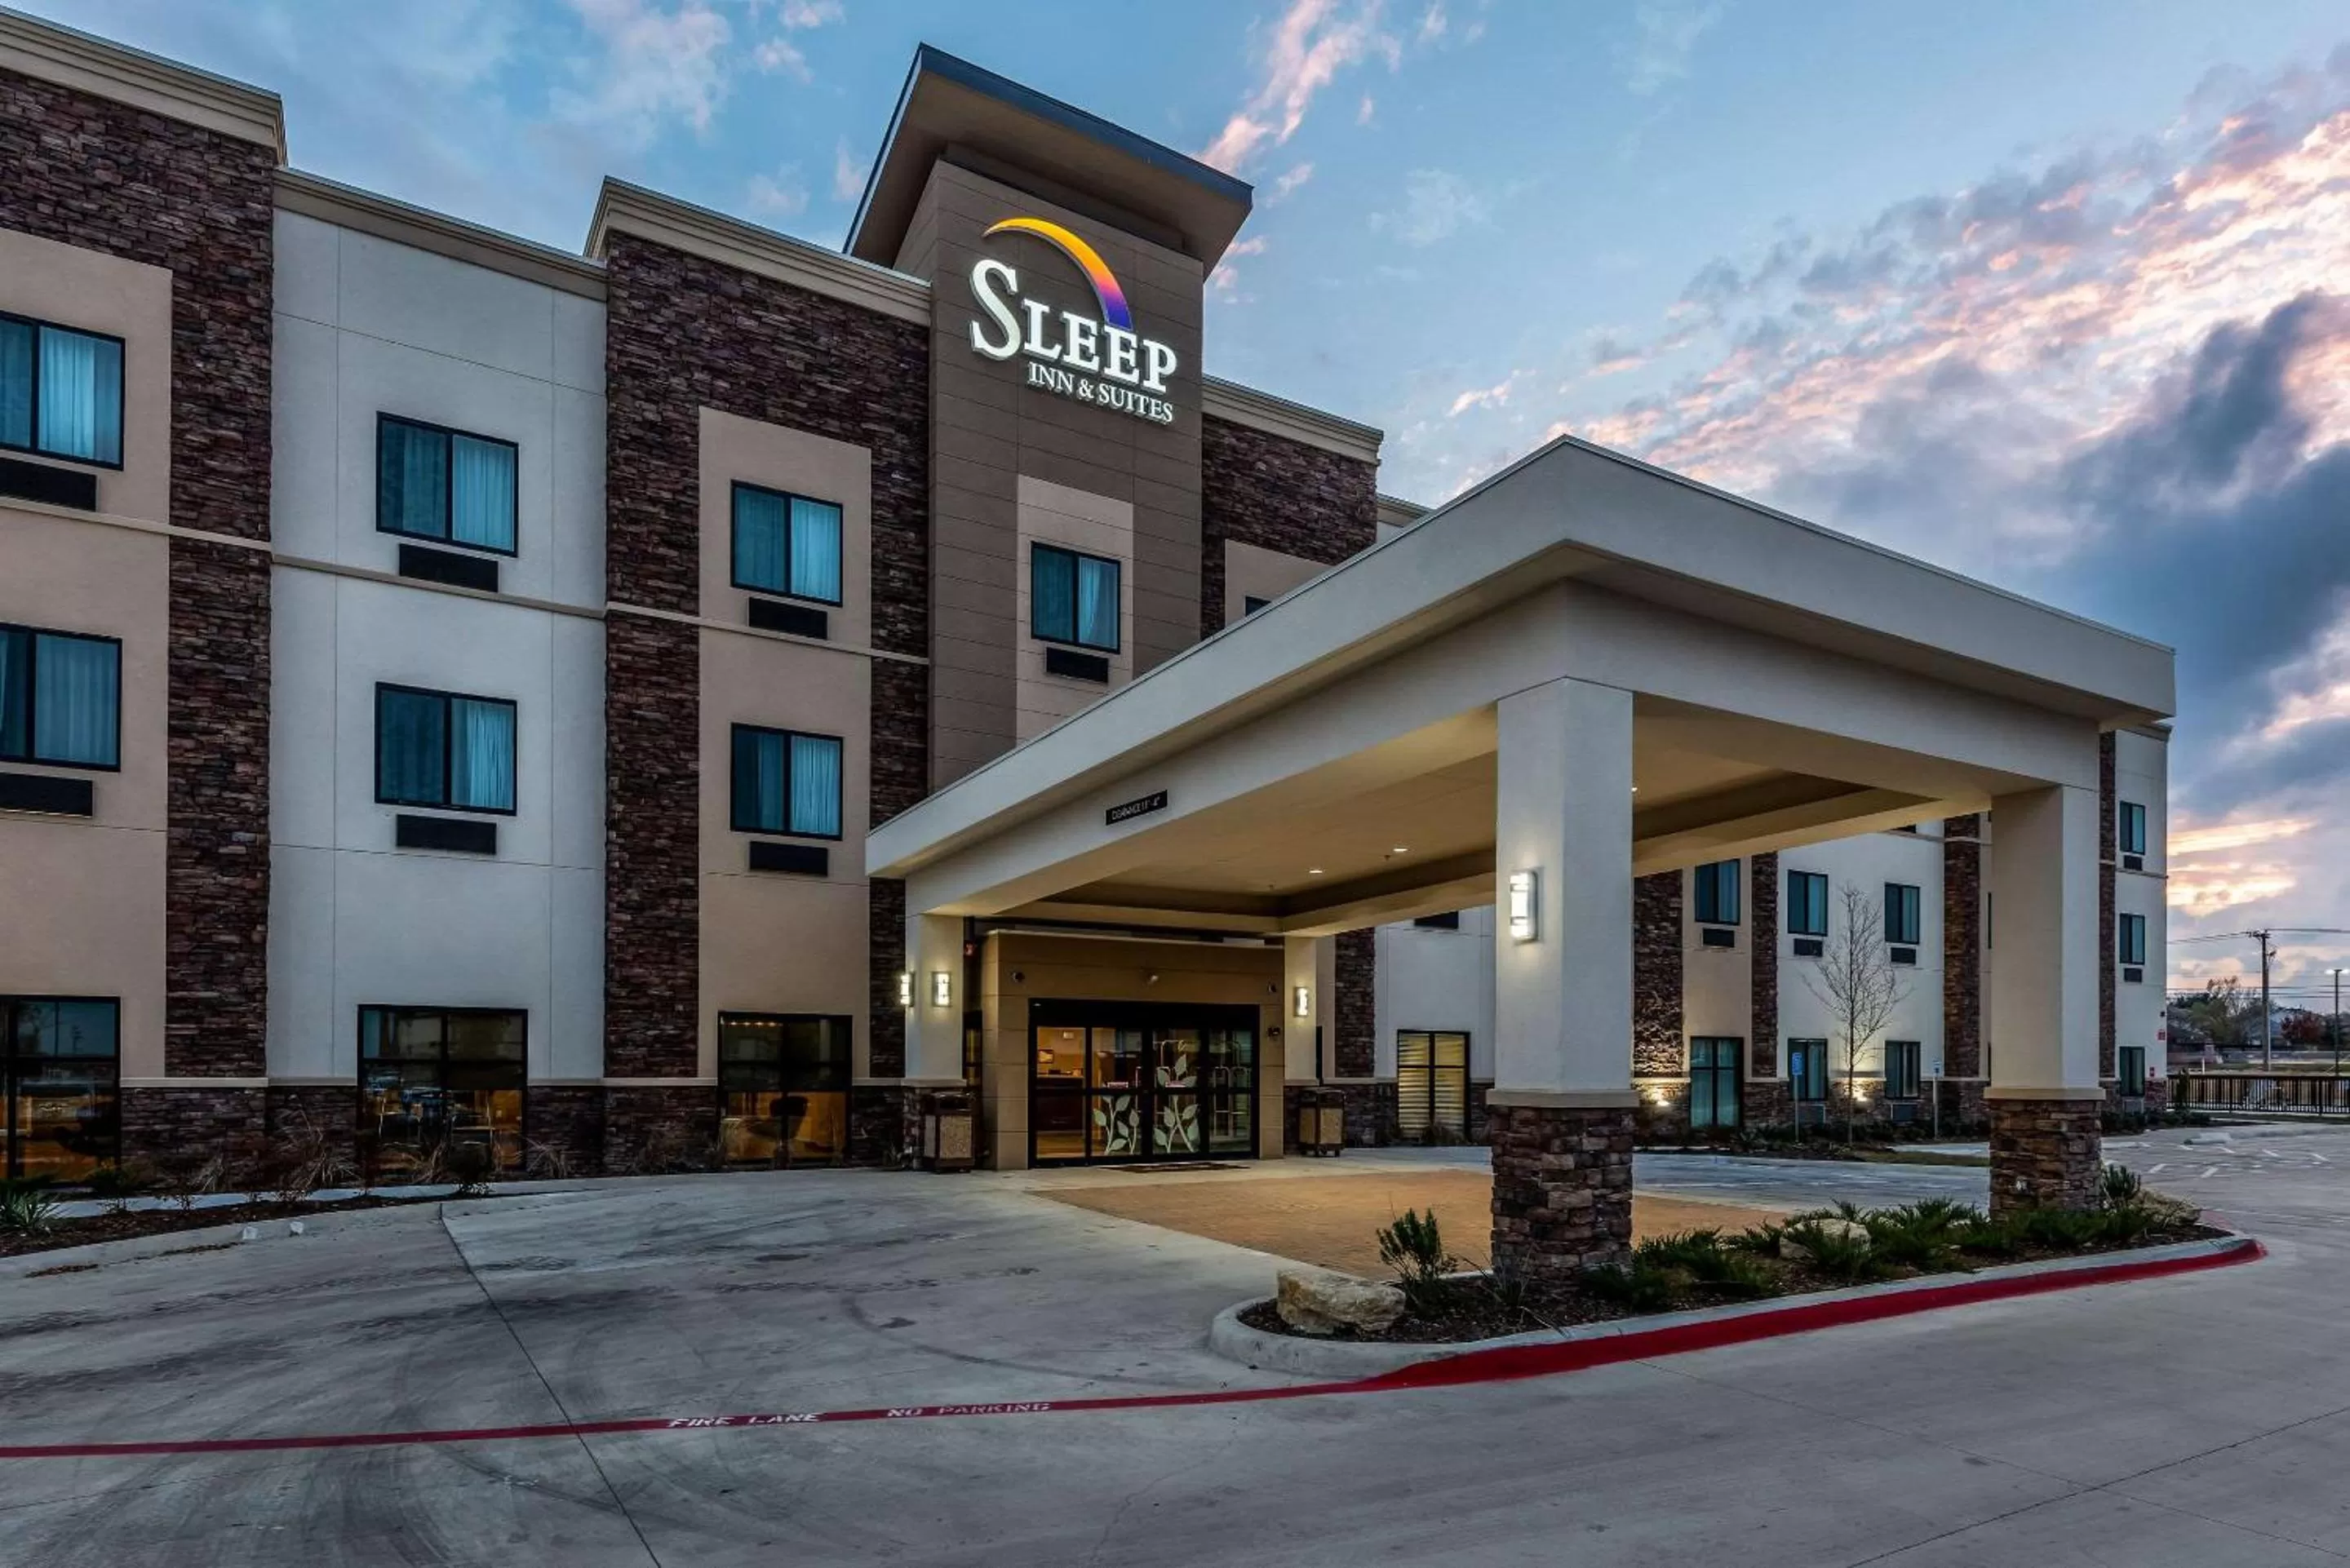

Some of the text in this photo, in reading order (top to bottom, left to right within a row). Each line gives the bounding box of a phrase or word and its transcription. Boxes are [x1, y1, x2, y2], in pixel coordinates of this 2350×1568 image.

[970, 259, 1177, 394] SLEEP
[1028, 362, 1173, 424] INN & SUITES
[668, 1413, 820, 1427] FIRE LANE
[887, 1402, 1051, 1418] NO PARKING
